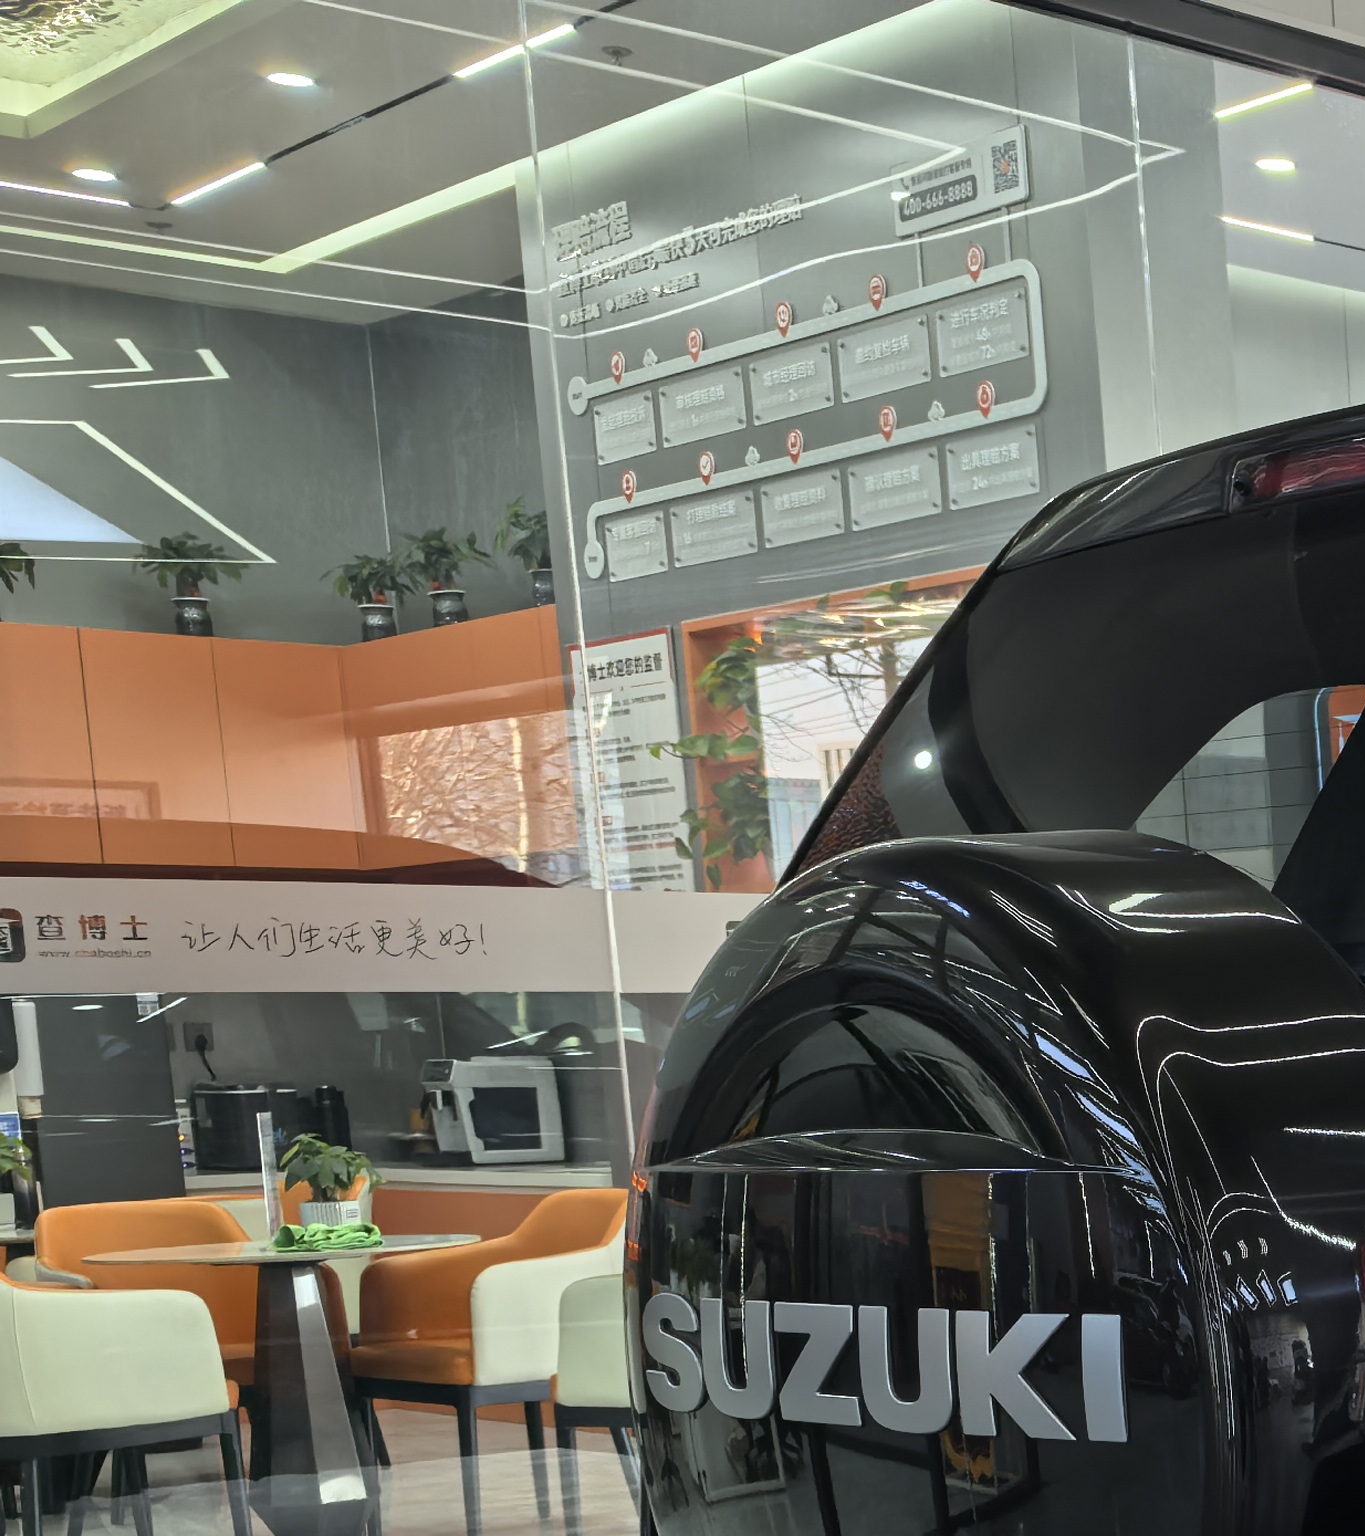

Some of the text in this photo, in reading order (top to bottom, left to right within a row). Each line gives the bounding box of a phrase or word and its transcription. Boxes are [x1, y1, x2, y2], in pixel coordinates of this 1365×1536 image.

[960, 442, 1021, 471] 出具理赔方案
[580, 652, 663, 681] 博士欢迎您的监督
[35, 914, 149, 941] 查博士
[642, 1292, 1129, 1443] SUZUKI
